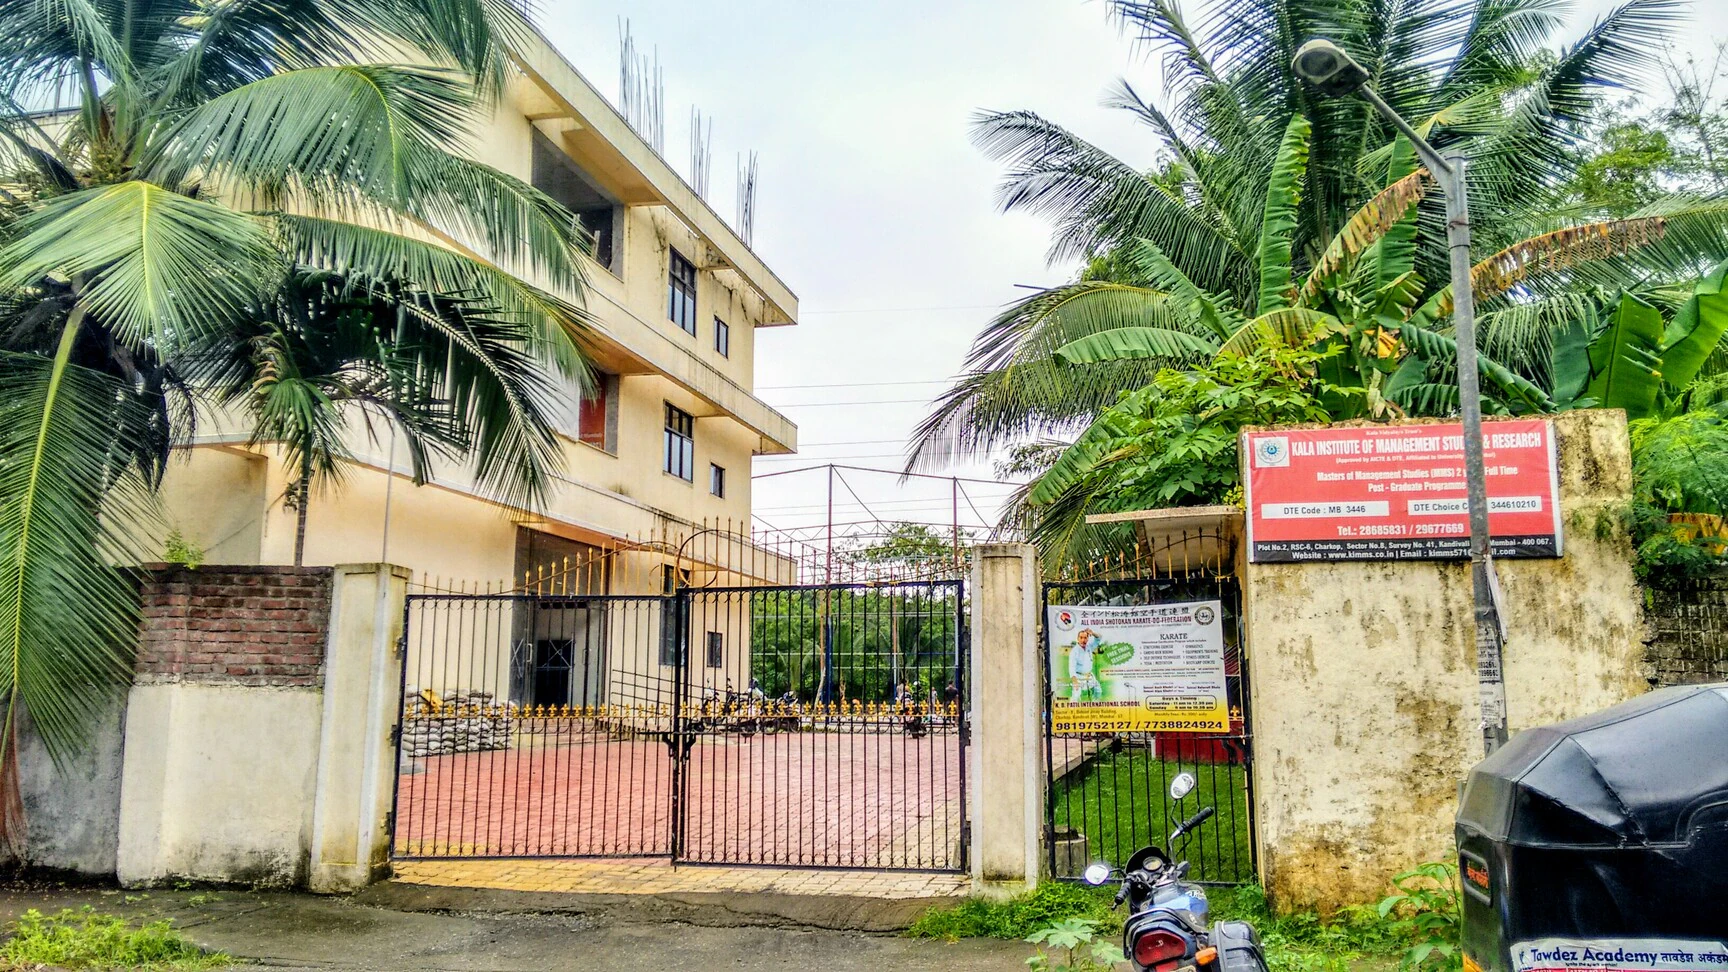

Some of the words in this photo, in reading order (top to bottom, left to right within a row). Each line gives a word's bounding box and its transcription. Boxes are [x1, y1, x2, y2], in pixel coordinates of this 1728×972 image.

[1292, 442, 1314, 456] KALA
[1316, 440, 1360, 455] INSTITUTE
[1362, 440, 1373, 454] OF
[1376, 437, 1440, 454] MANAGEMENT
[1483, 434, 1490, 448] &
[1492, 432, 1541, 448] RESEARCH
[1317, 472, 1345, 481] Masters
[1347, 471, 1354, 480] of
[1355, 470, 1401, 481] Management
[1402, 469, 1429, 479] Studies
[1431, 468, 1455, 479] (MMS)
[1456, 468, 1462, 477] 2
[1485, 467, 1498, 476] Full
[1500, 466, 1518, 475] Time
[1368, 483, 1384, 492] Post
[1390, 482, 1422, 492] Graduate
[1424, 481, 1466, 492] Programme
[1432, 503, 1460, 511] Choice
[1491, 500, 1536, 509] 344610210
[1359, 524, 1406, 536] 28685831
[1409, 524, 1413, 535] /
[1416, 523, 1464, 534] 29677669
[1271, 543, 1289, 551] No.2,
[1389, 541, 1411, 550] Survey
[1292, 551, 1322, 560] Website
[1328, 551, 1394, 559] www.kimms.co.in
[1056, 722, 1131, 730] 9819752127
[1531, 947, 1578, 962] Tawdez
[1583, 948, 1657, 966] Academy
